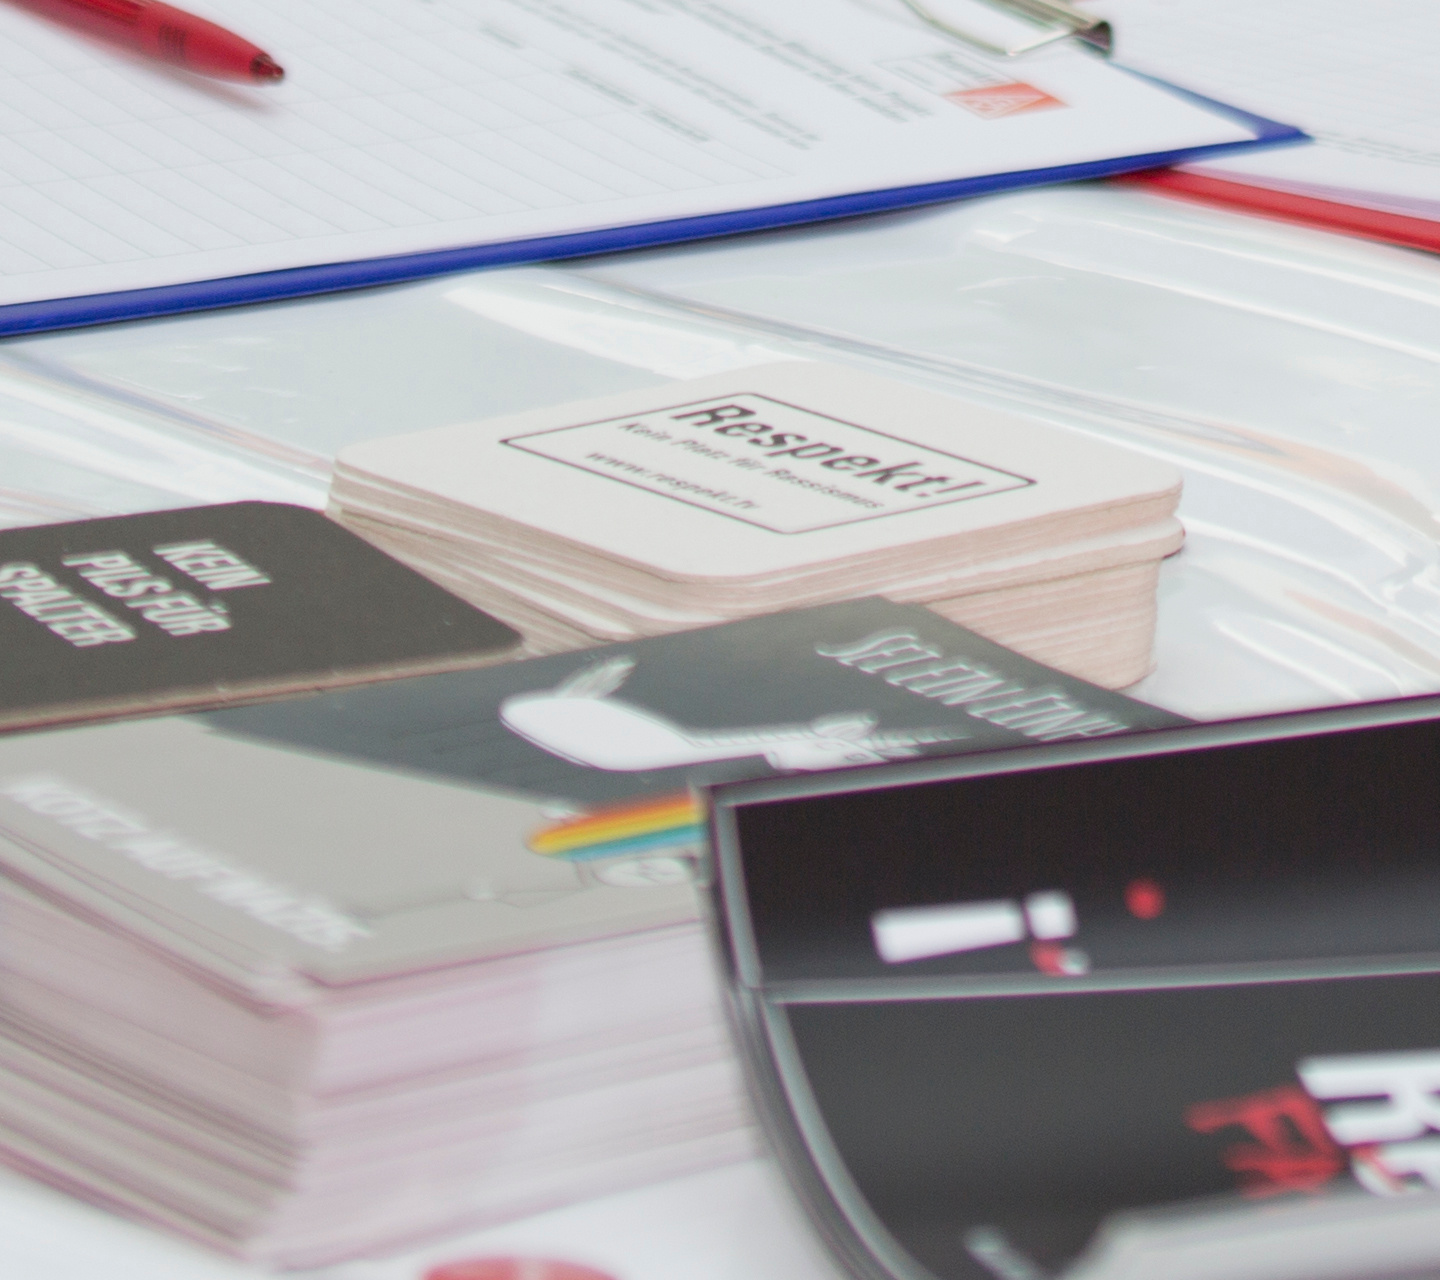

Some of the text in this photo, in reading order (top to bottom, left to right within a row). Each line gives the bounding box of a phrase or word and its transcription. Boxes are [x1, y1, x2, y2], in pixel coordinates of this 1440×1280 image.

[584, 449, 763, 511] www.respekt.tv
[670, 402, 987, 498] Respekt!
[767, 465, 885, 510] Rassismus
[62, 550, 233, 637] PILS FÜR
[152, 539, 272, 591] KEIN
